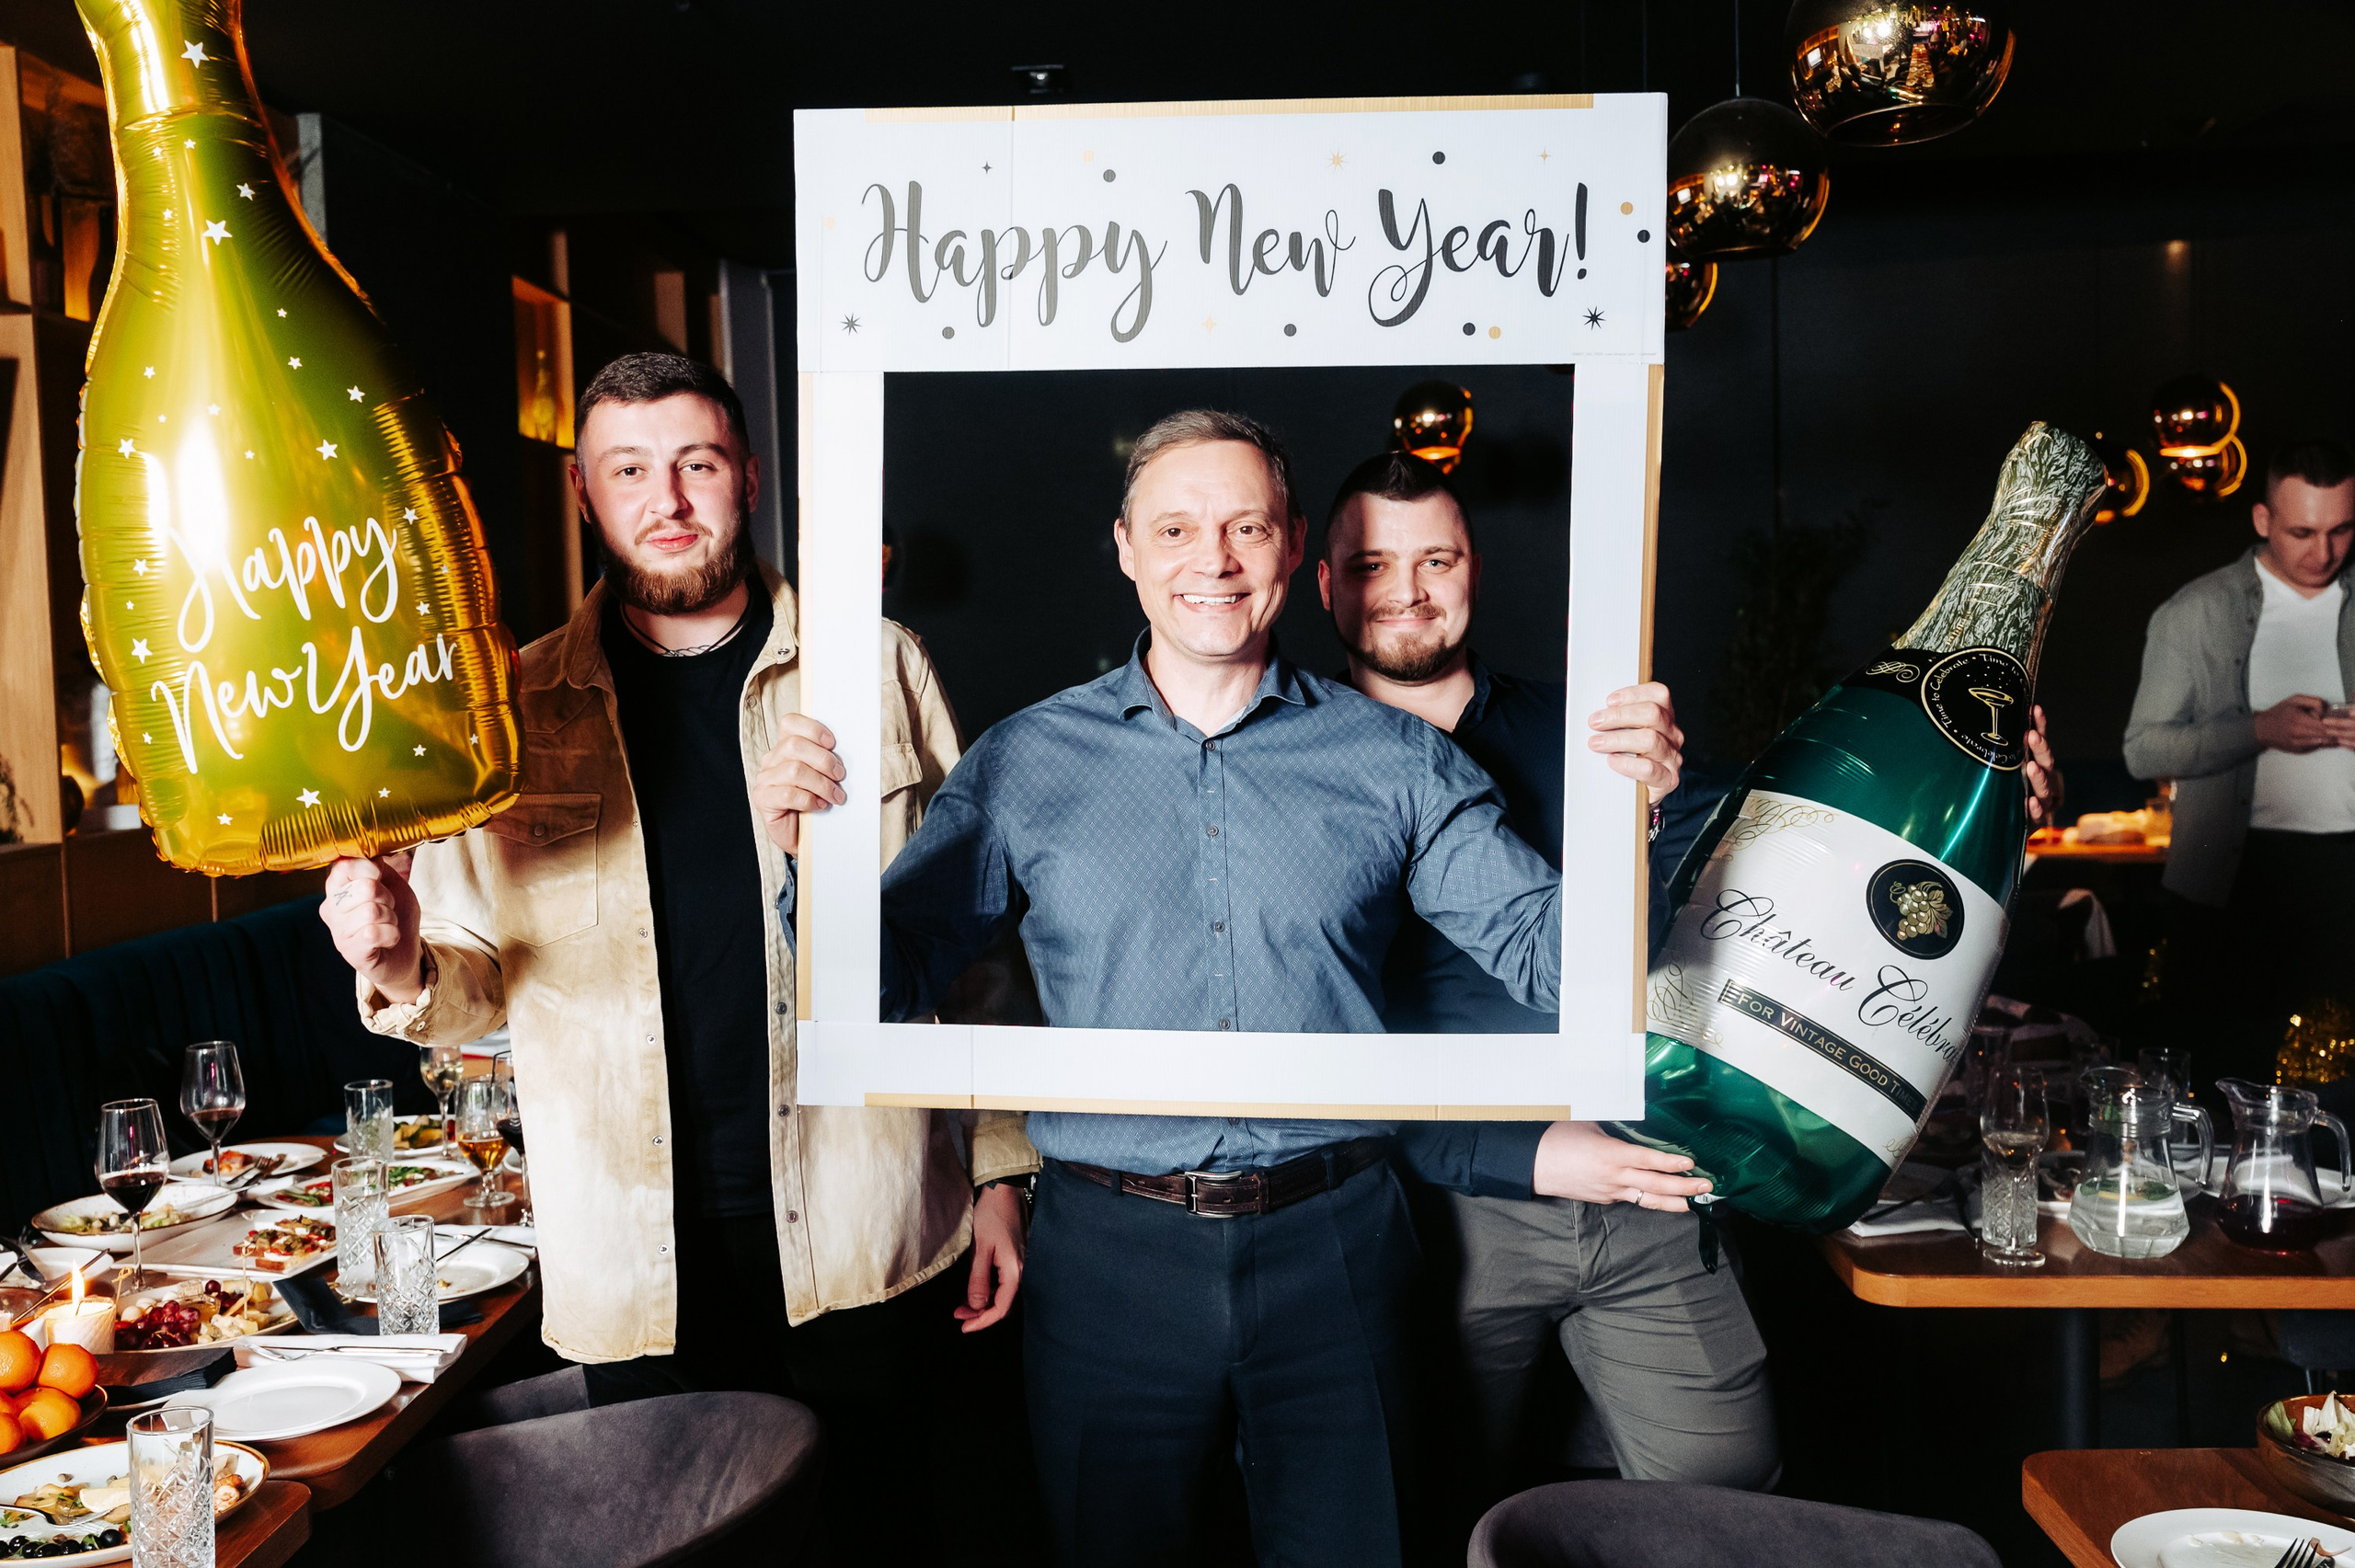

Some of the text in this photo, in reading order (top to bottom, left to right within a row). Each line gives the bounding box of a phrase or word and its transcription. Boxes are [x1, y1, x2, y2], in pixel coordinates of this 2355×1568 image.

[860, 179, 1589, 344] Happy New Year!
[150, 515, 458, 774] Happy New Year
[1930, 658, 1970, 728] Time to Celebrate
[1979, 653, 2008, 667] Time
[1700, 888, 1856, 992] Château
